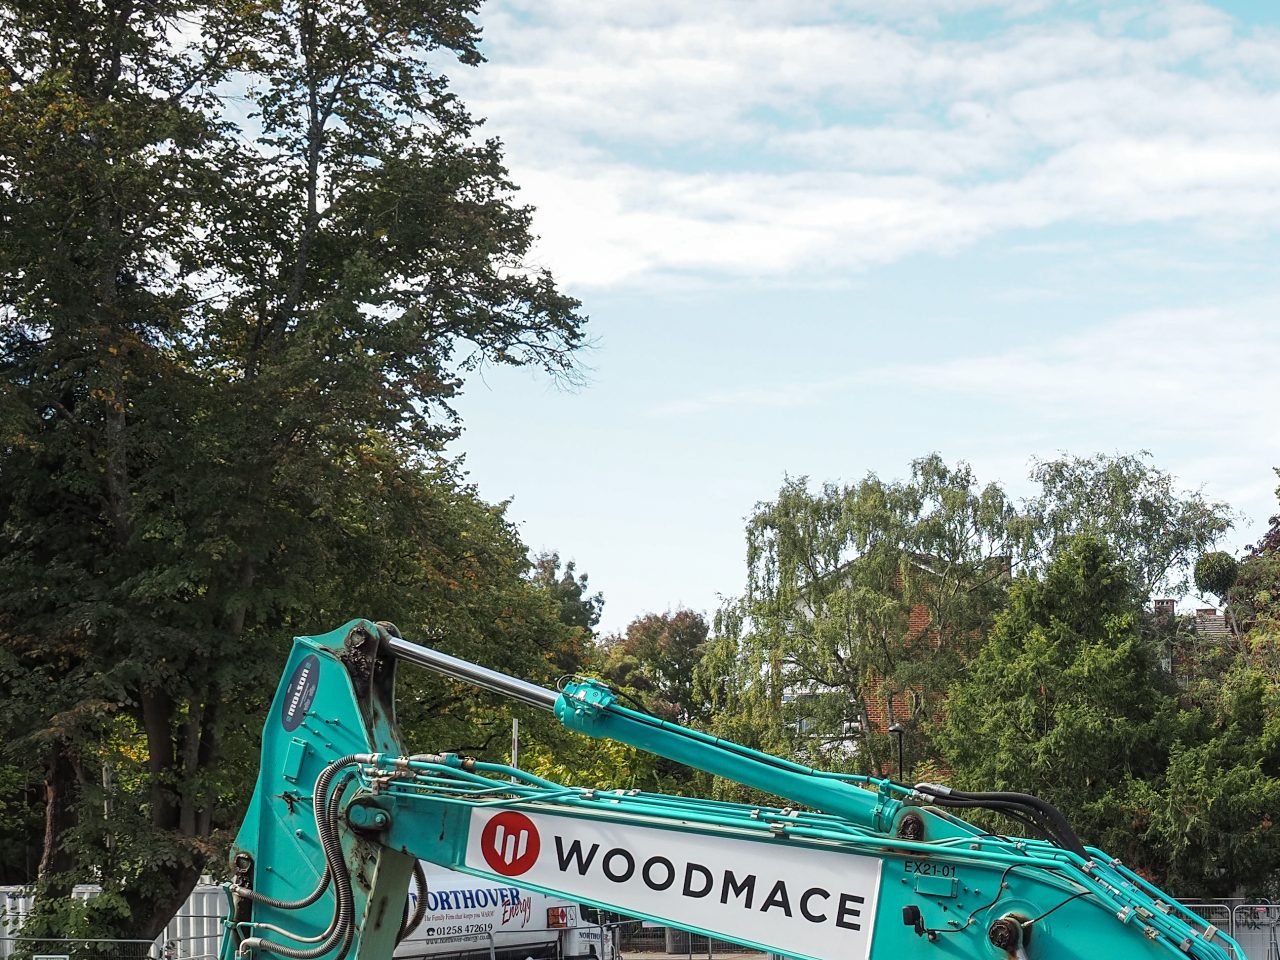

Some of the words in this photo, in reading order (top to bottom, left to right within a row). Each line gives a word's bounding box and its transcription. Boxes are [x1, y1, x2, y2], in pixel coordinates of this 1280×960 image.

[904, 861, 956, 877] EX21-01
[553, 835, 865, 932] WOODMACE
[501, 896, 532, 929] Energy
[437, 925, 463, 936] 01258
[464, 923, 493, 934] 472619
